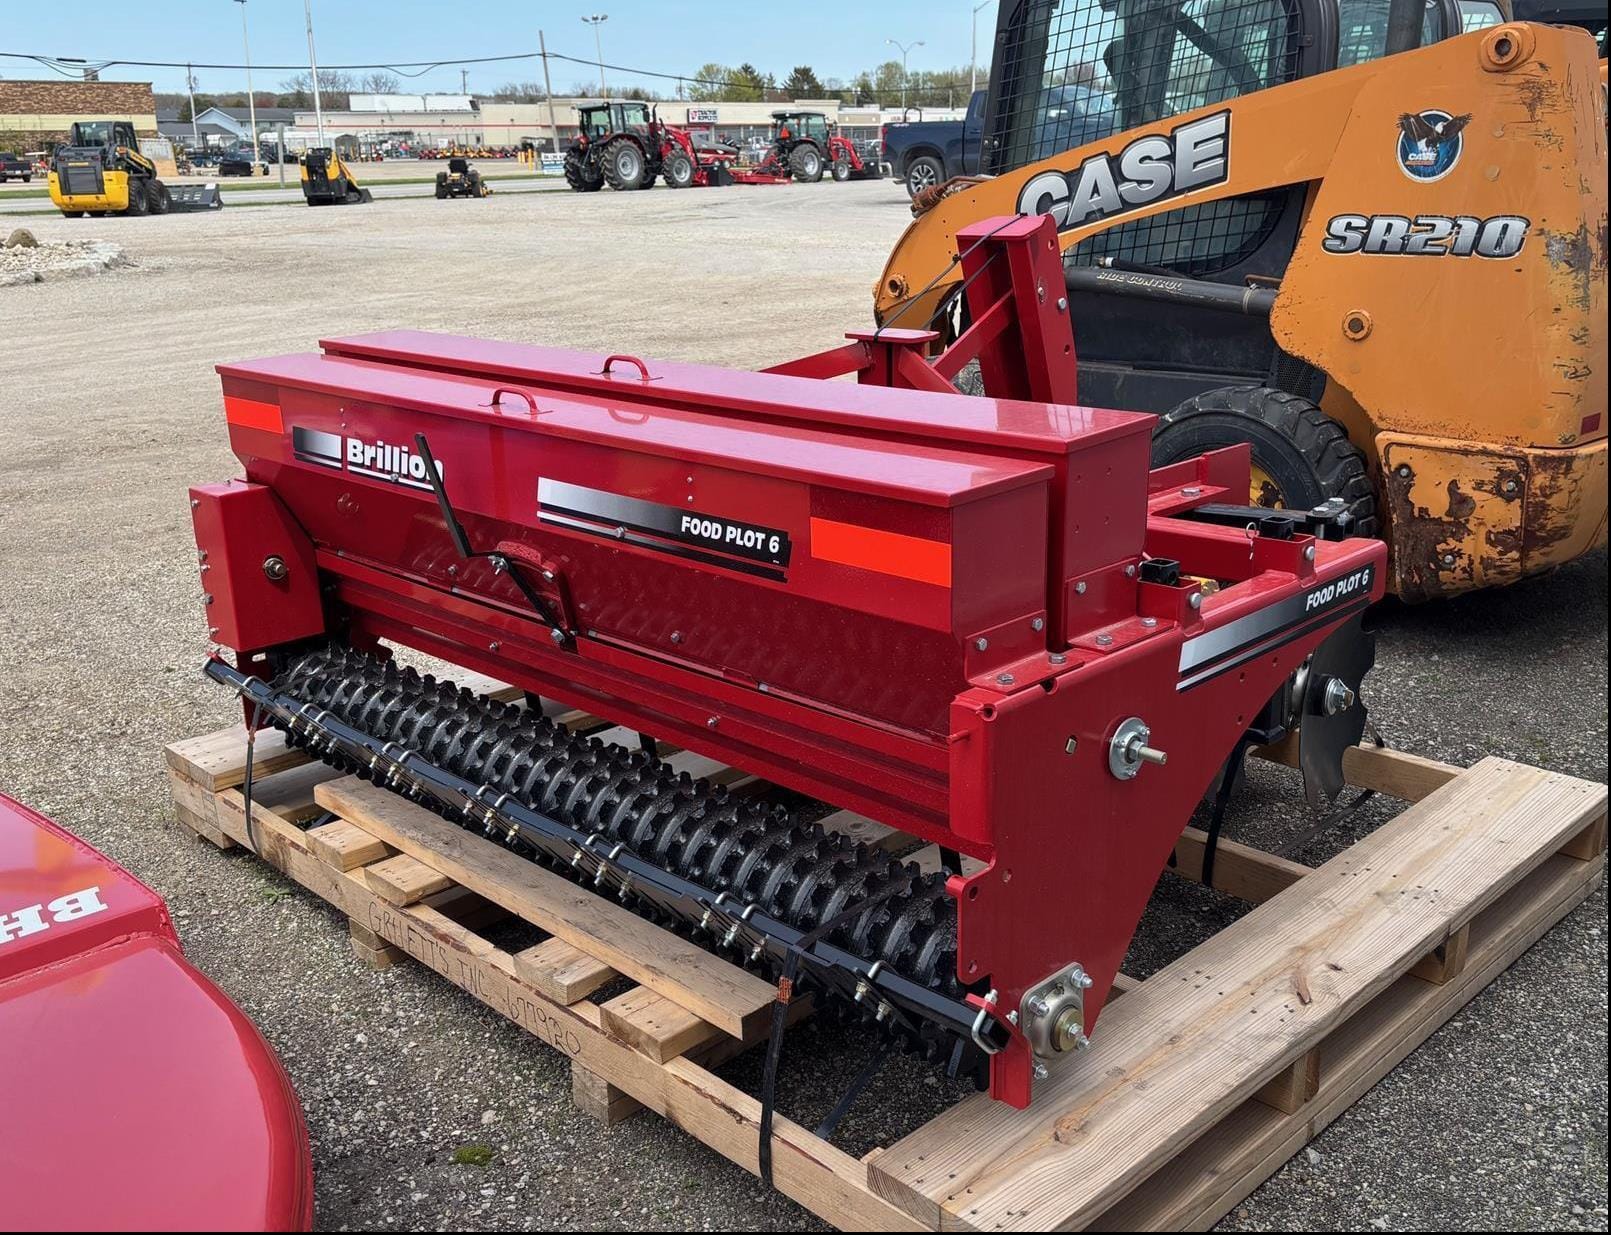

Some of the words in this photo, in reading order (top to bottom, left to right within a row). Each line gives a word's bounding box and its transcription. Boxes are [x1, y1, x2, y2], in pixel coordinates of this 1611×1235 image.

[1018, 110, 1230, 228] CASE
[1321, 214, 1530, 258] SR210
[1096, 271, 1126, 282] RIDE
[1126, 275, 1184, 291] CONTROL
[681, 515, 722, 539] FOOD
[725, 525, 766, 550] PLOT
[769, 535, 780, 553] 6
[1305, 585, 1335, 612] FOOD
[1335, 572, 1361, 598] PLOT
[1361, 569, 1370, 586] 6
